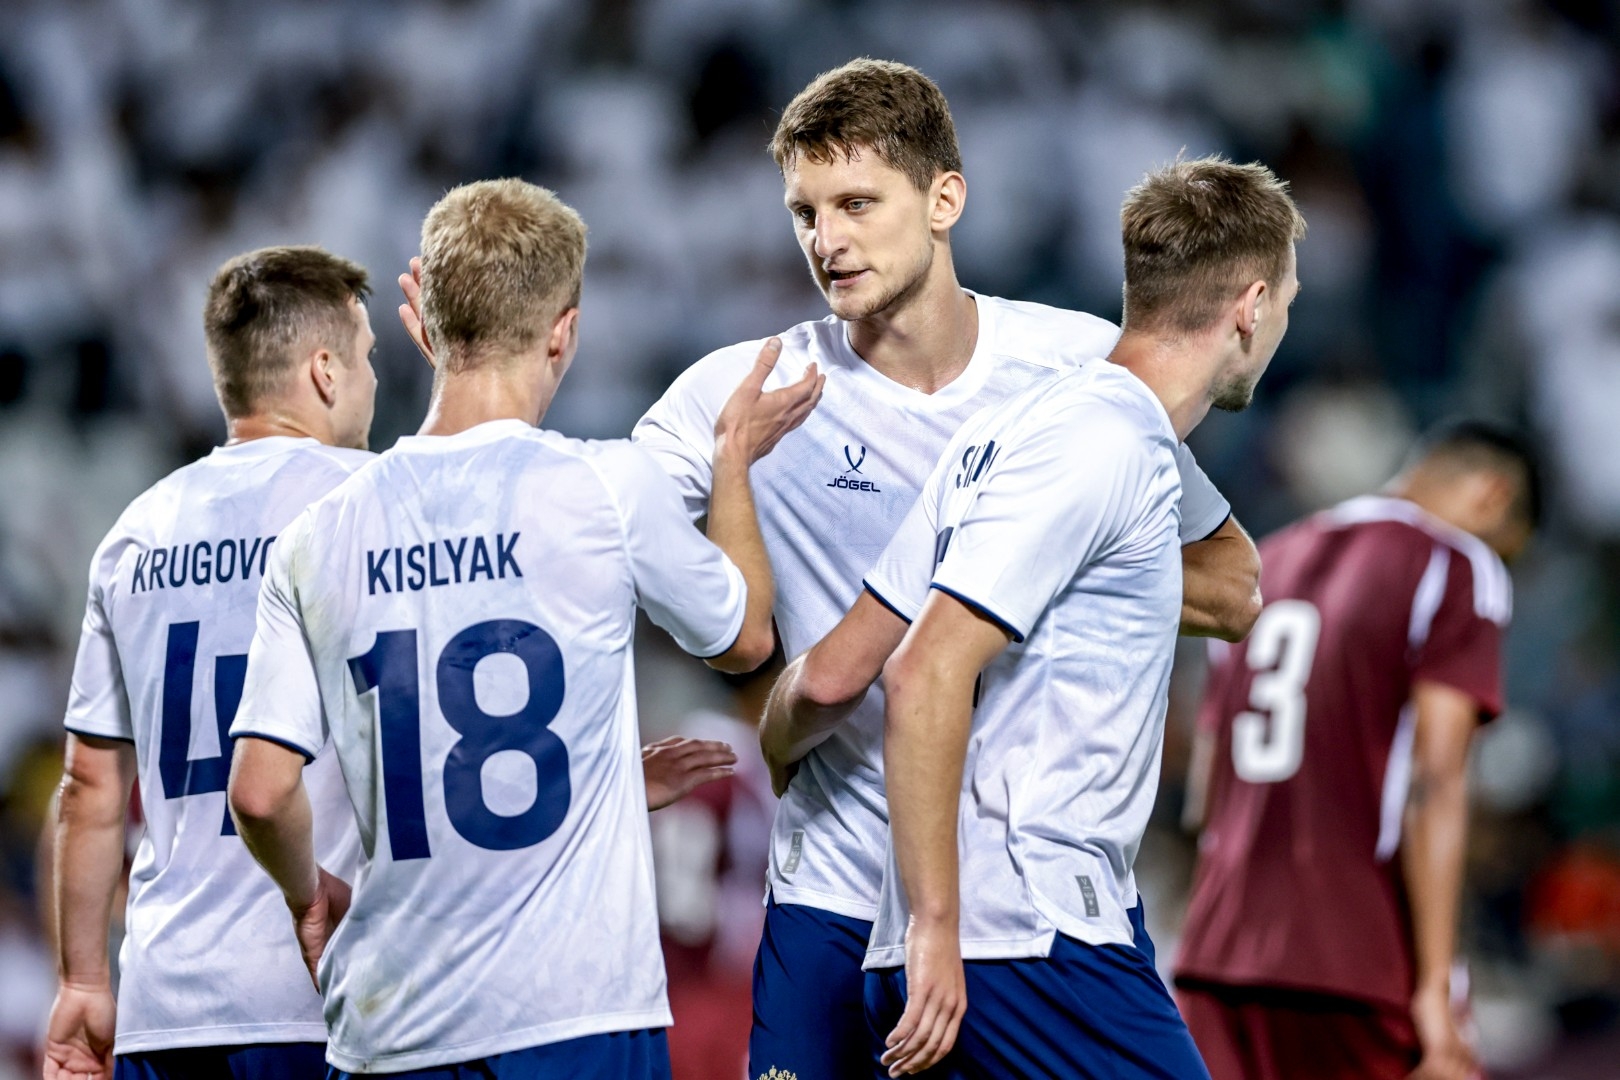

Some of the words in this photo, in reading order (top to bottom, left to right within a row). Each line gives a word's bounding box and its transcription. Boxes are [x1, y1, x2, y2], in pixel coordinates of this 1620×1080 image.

[367, 532, 523, 595] KISLYAK
[826, 475, 881, 493] JÖGEL
[159, 620, 249, 836] 4
[347, 618, 572, 861] 18
[1231, 598, 1321, 783] 3
